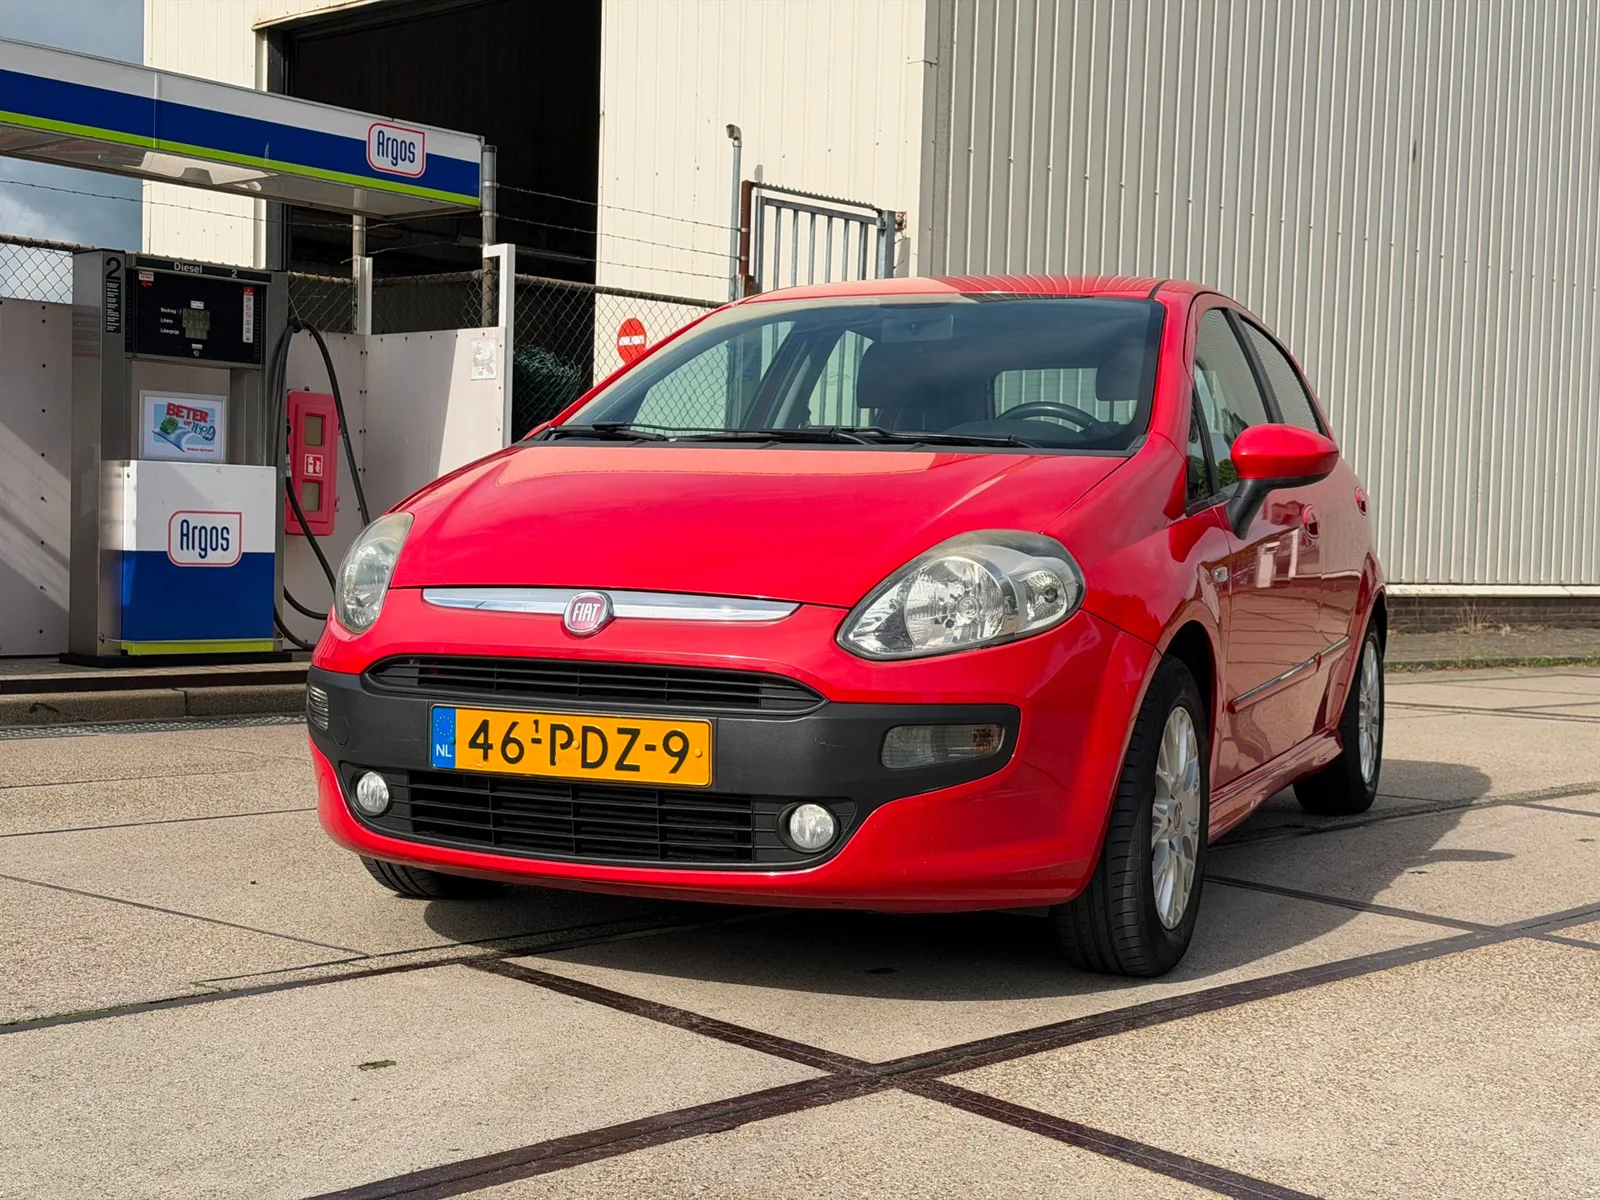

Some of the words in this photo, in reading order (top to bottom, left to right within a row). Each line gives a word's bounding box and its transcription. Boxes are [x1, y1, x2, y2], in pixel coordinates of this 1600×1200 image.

[377, 130, 416, 167] Argos
[106, 256, 121, 280] 2
[173, 261, 203, 275] Diesel
[231, 269, 238, 279] 2
[166, 402, 209, 424] BETER
[180, 519, 230, 560] Argos
[571, 602, 601, 622] FIAT
[435, 744, 453, 758] NL
